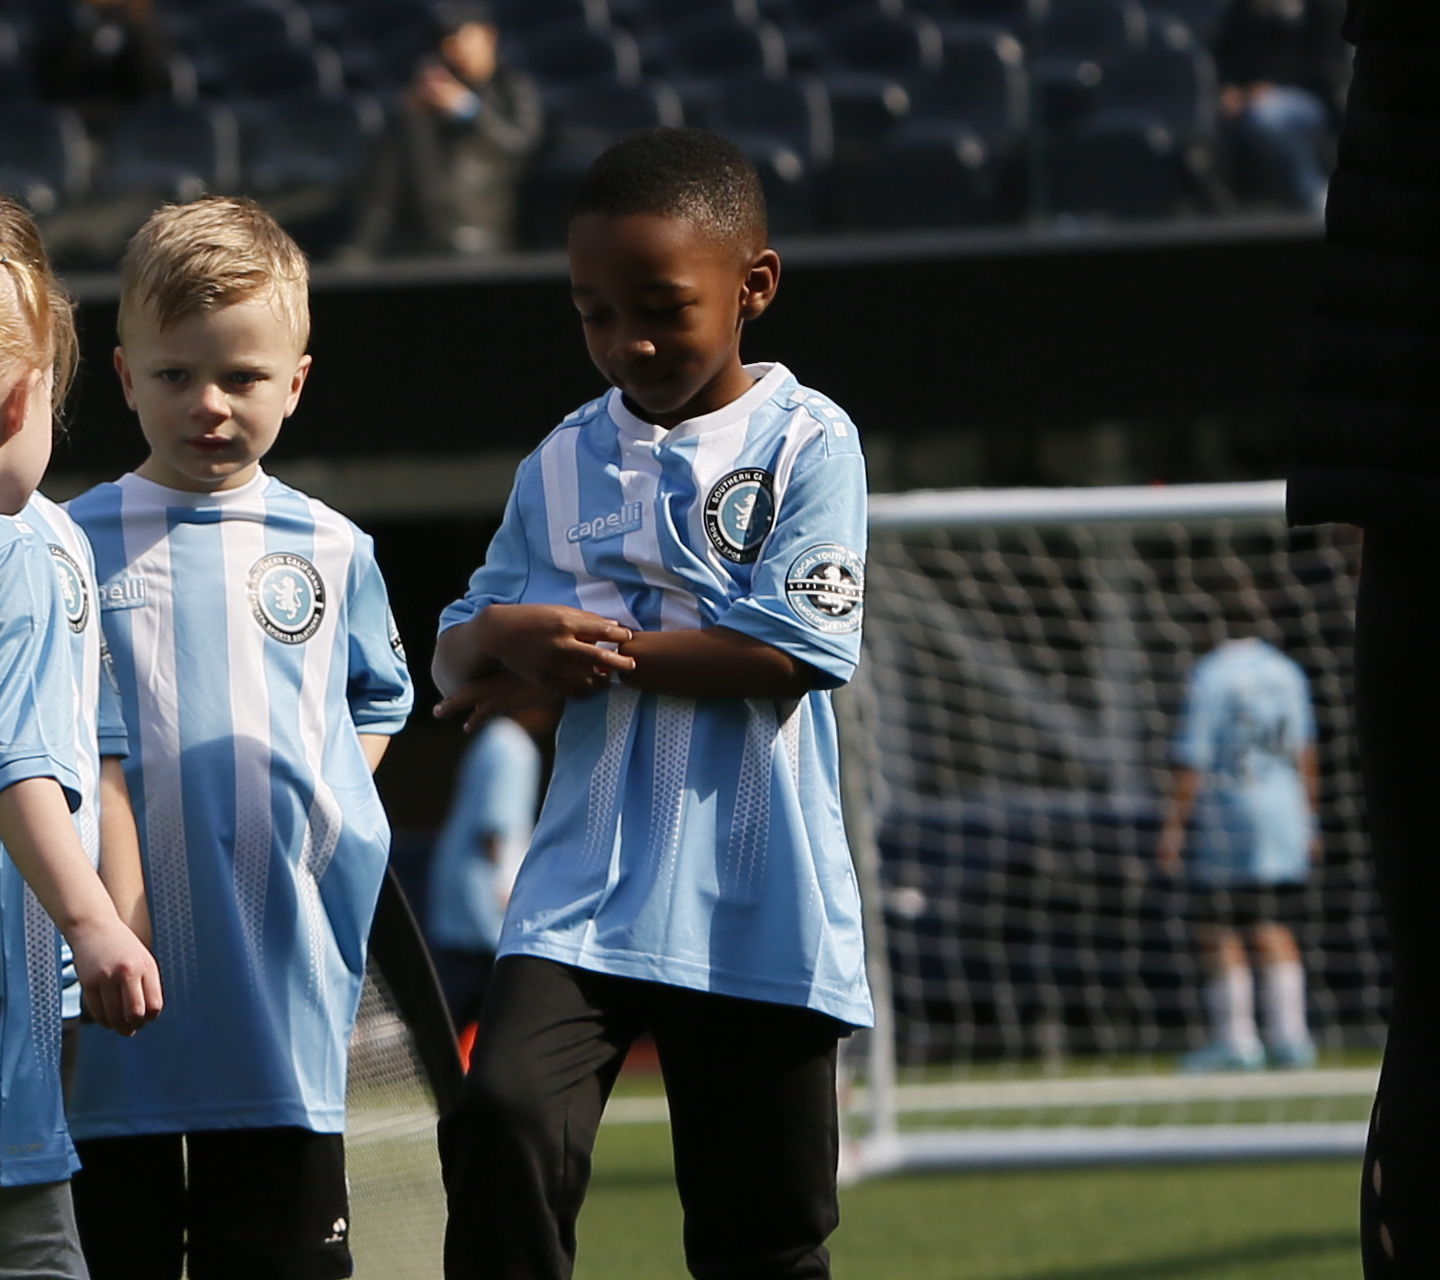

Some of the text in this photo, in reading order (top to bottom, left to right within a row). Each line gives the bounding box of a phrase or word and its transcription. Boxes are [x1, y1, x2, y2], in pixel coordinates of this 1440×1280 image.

[711, 473, 751, 504] SOUTHERN
[568, 503, 640, 538] capelli
[815, 551, 845, 563] YOUTH
